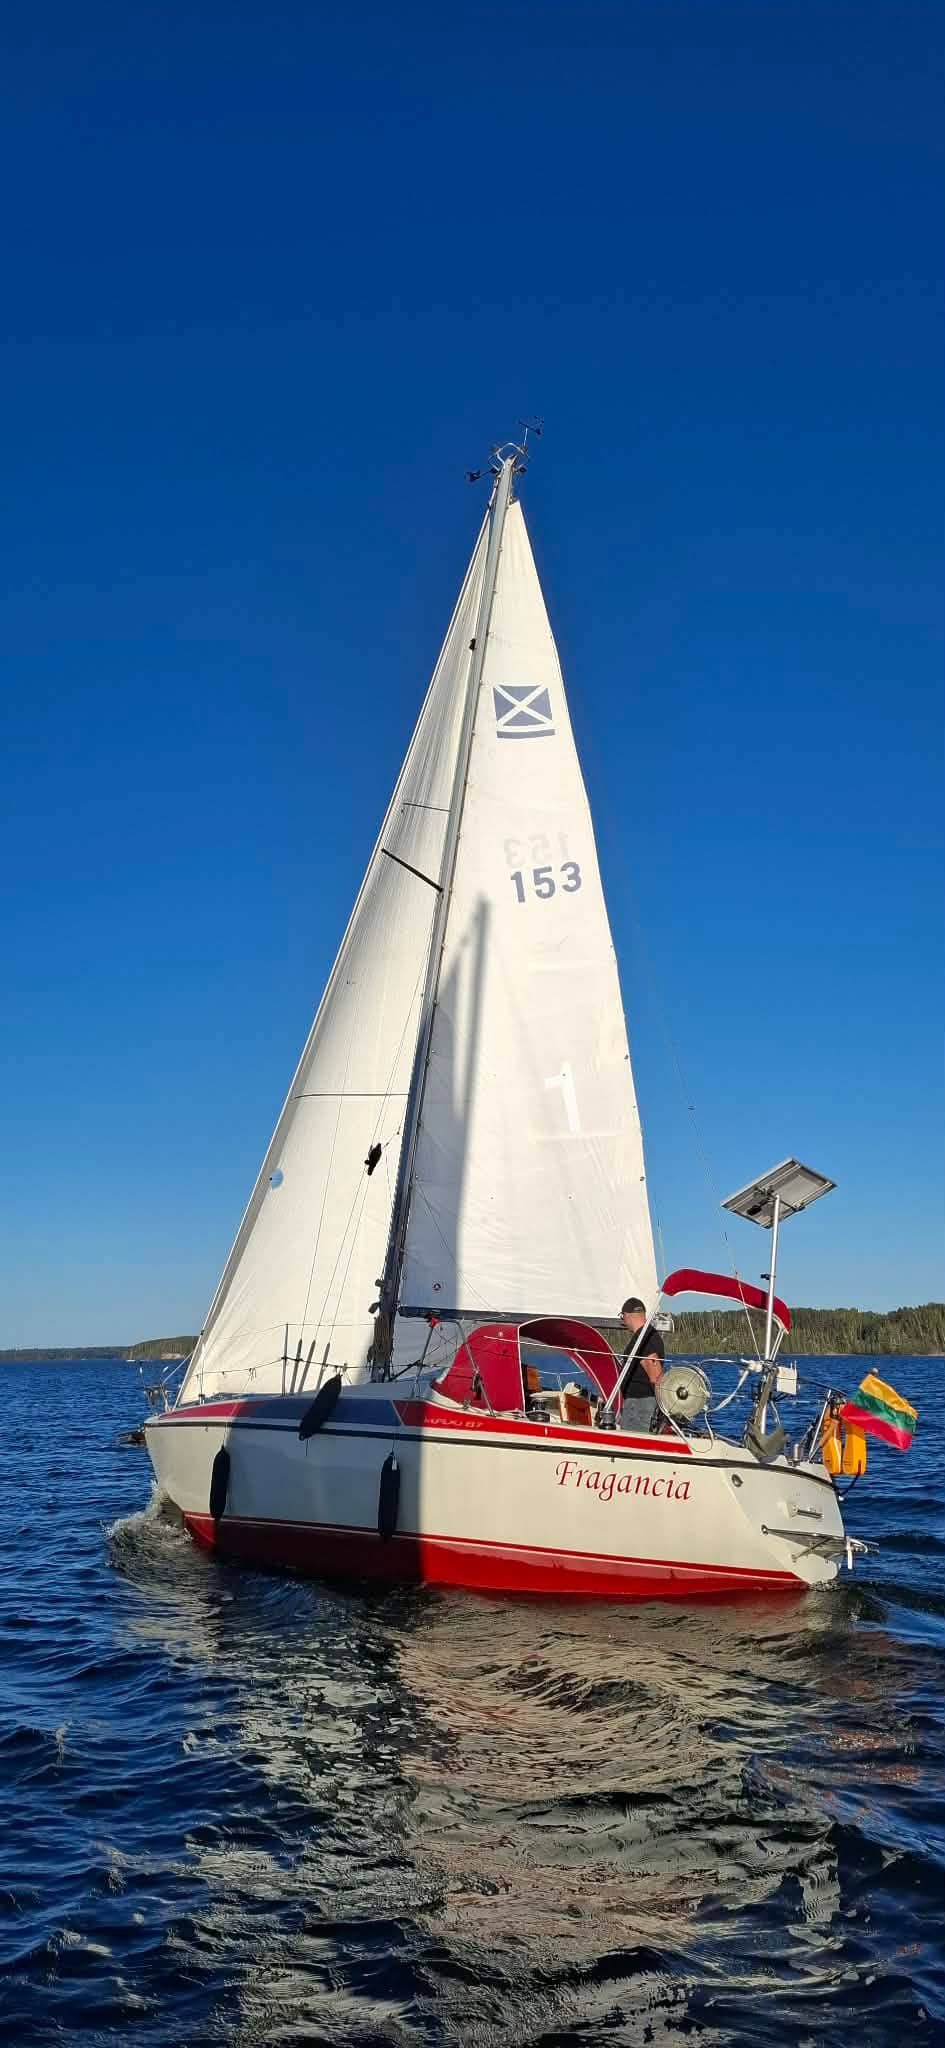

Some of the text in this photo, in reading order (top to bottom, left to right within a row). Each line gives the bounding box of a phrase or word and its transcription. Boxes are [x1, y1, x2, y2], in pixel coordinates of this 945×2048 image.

[510, 861, 582, 904] 153
[544, 1061, 581, 1132] 1
[555, 1460, 692, 1502] Fragancia
